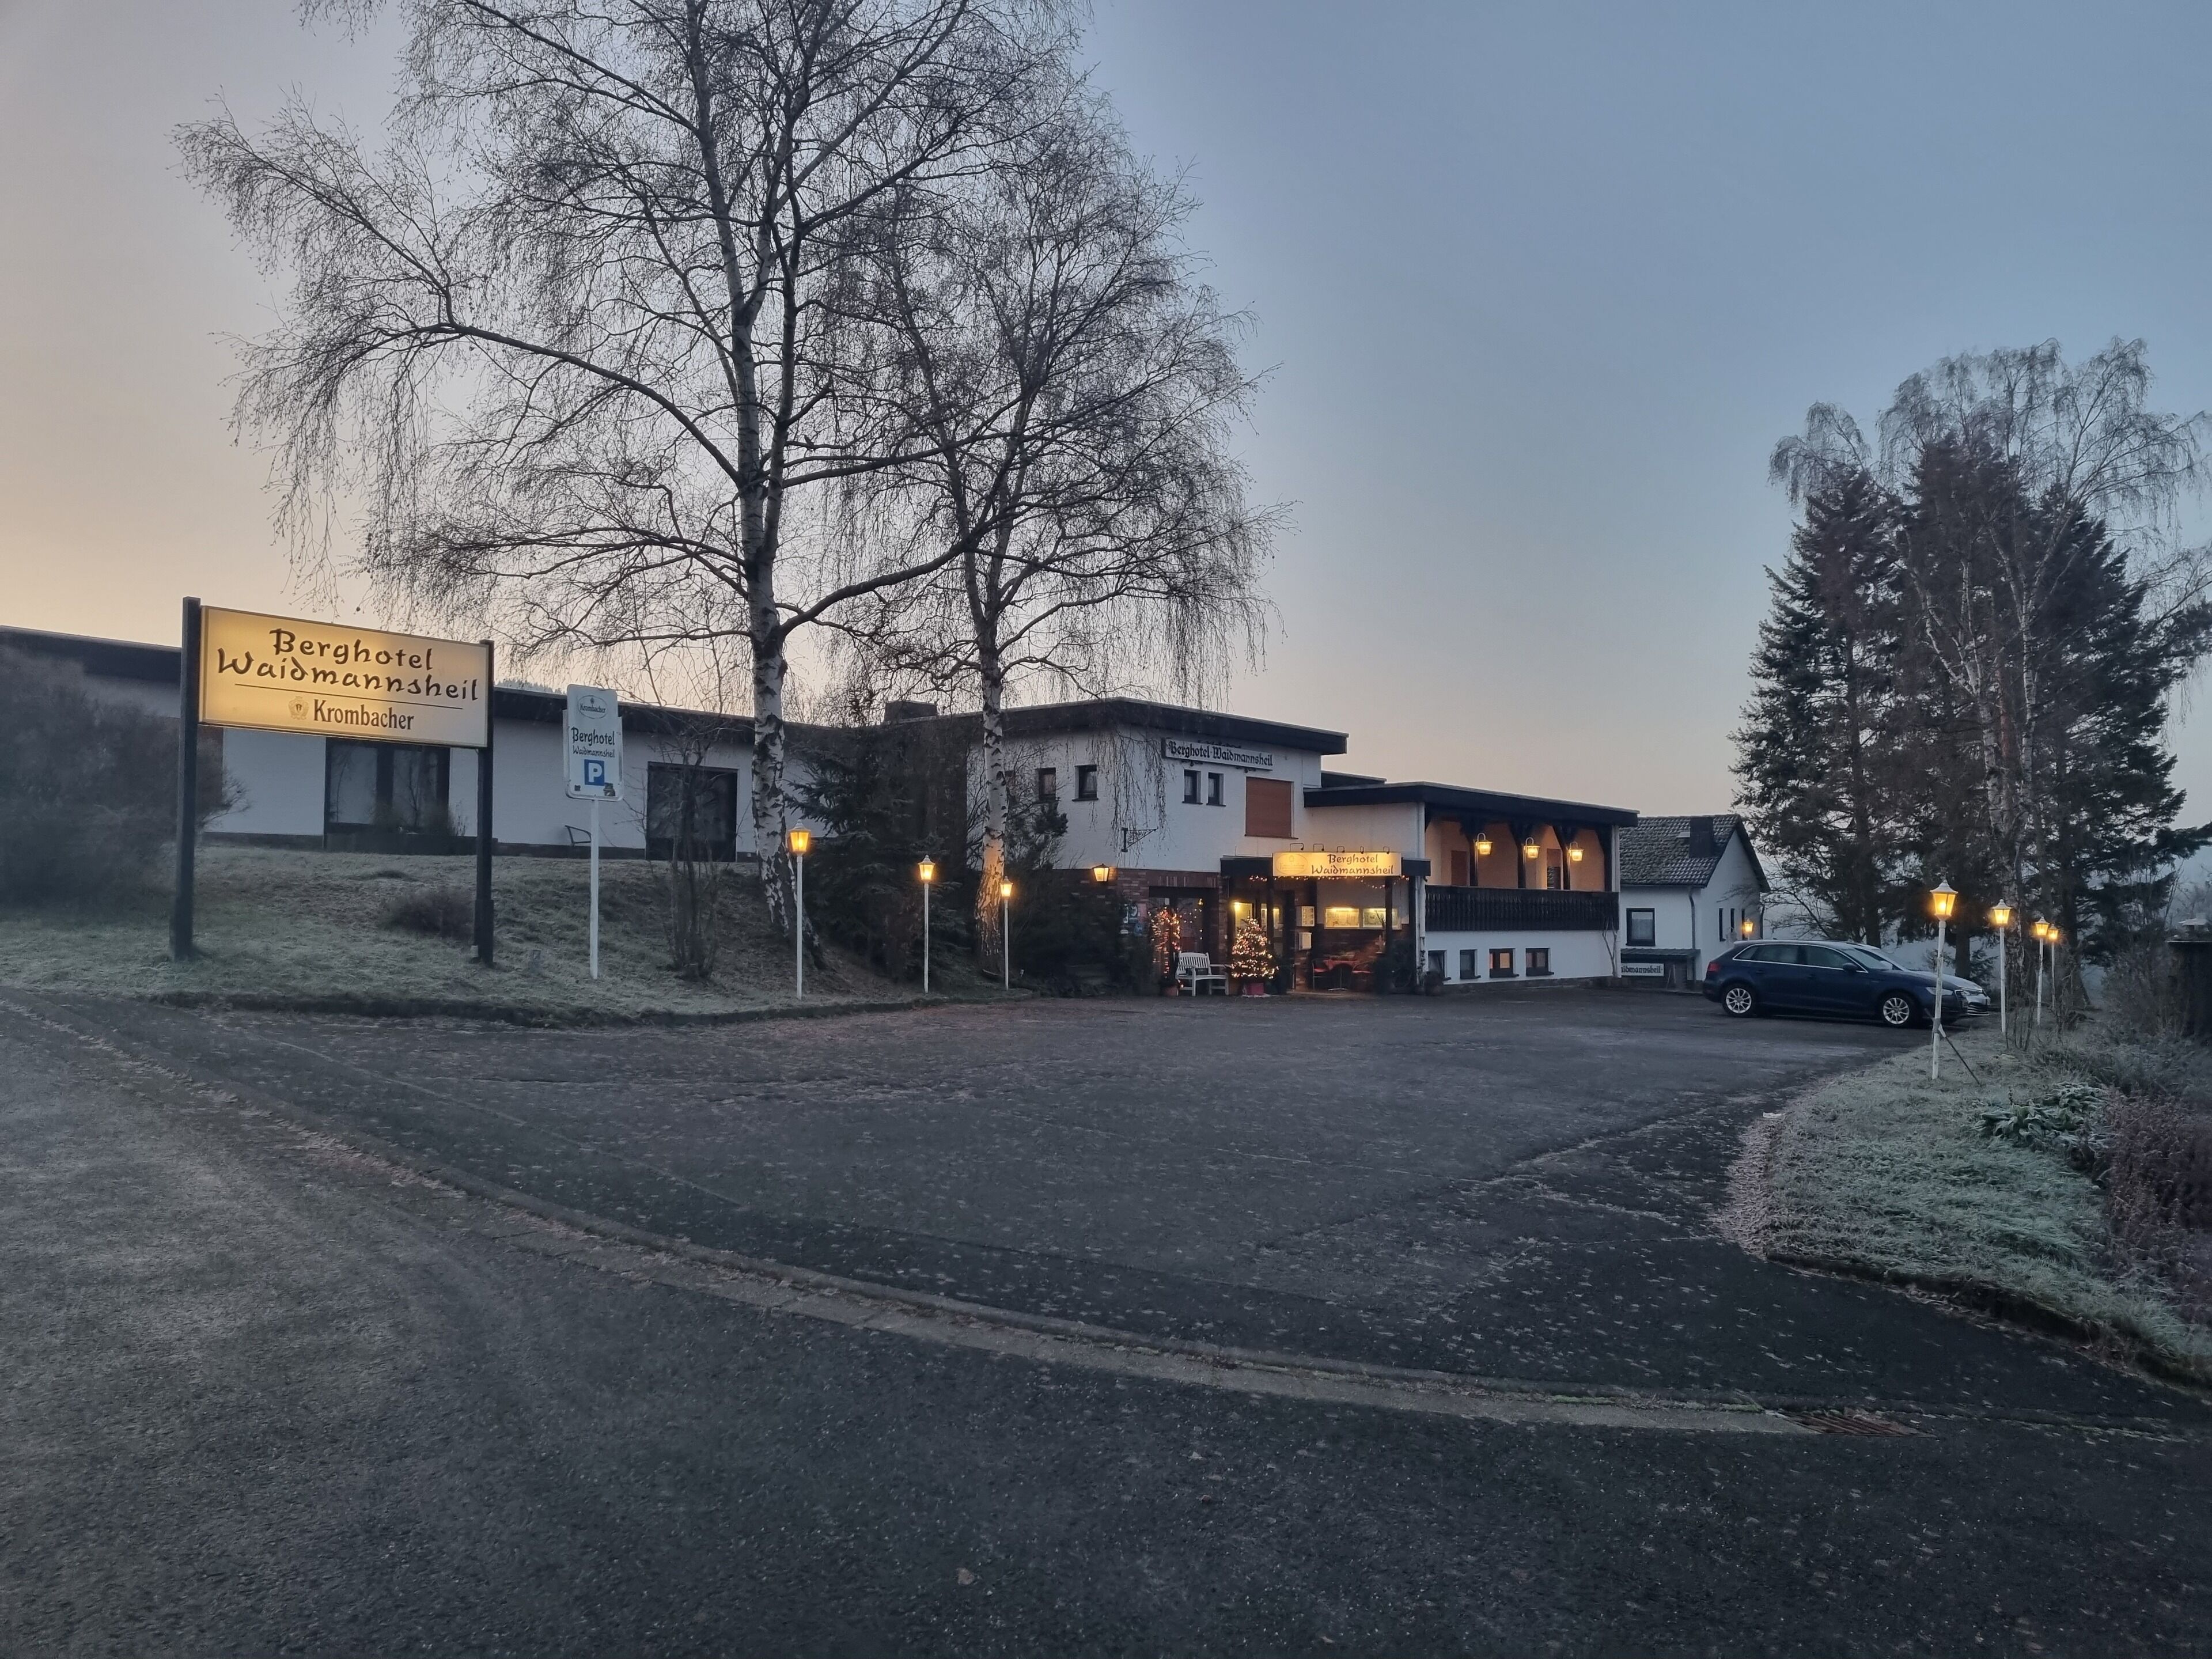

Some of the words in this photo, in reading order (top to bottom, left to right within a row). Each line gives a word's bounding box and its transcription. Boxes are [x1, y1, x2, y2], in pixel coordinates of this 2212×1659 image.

[270, 628, 433, 671] Berghotel
[217, 647, 479, 702] Waidmannsheil
[313, 699, 415, 730] Krombacher
[580, 703, 606, 714] Krombacher
[571, 726, 615, 747] Berghotel
[573, 745, 615, 759] Waidmannsheil
[1168, 740, 1210, 759] Berghotel
[1212, 746, 1274, 766] Waidmannsheil
[588, 762, 603, 782] P
[1327, 853, 1378, 865] Berghotel
[1311, 865, 1394, 874] Waidmannsheil
